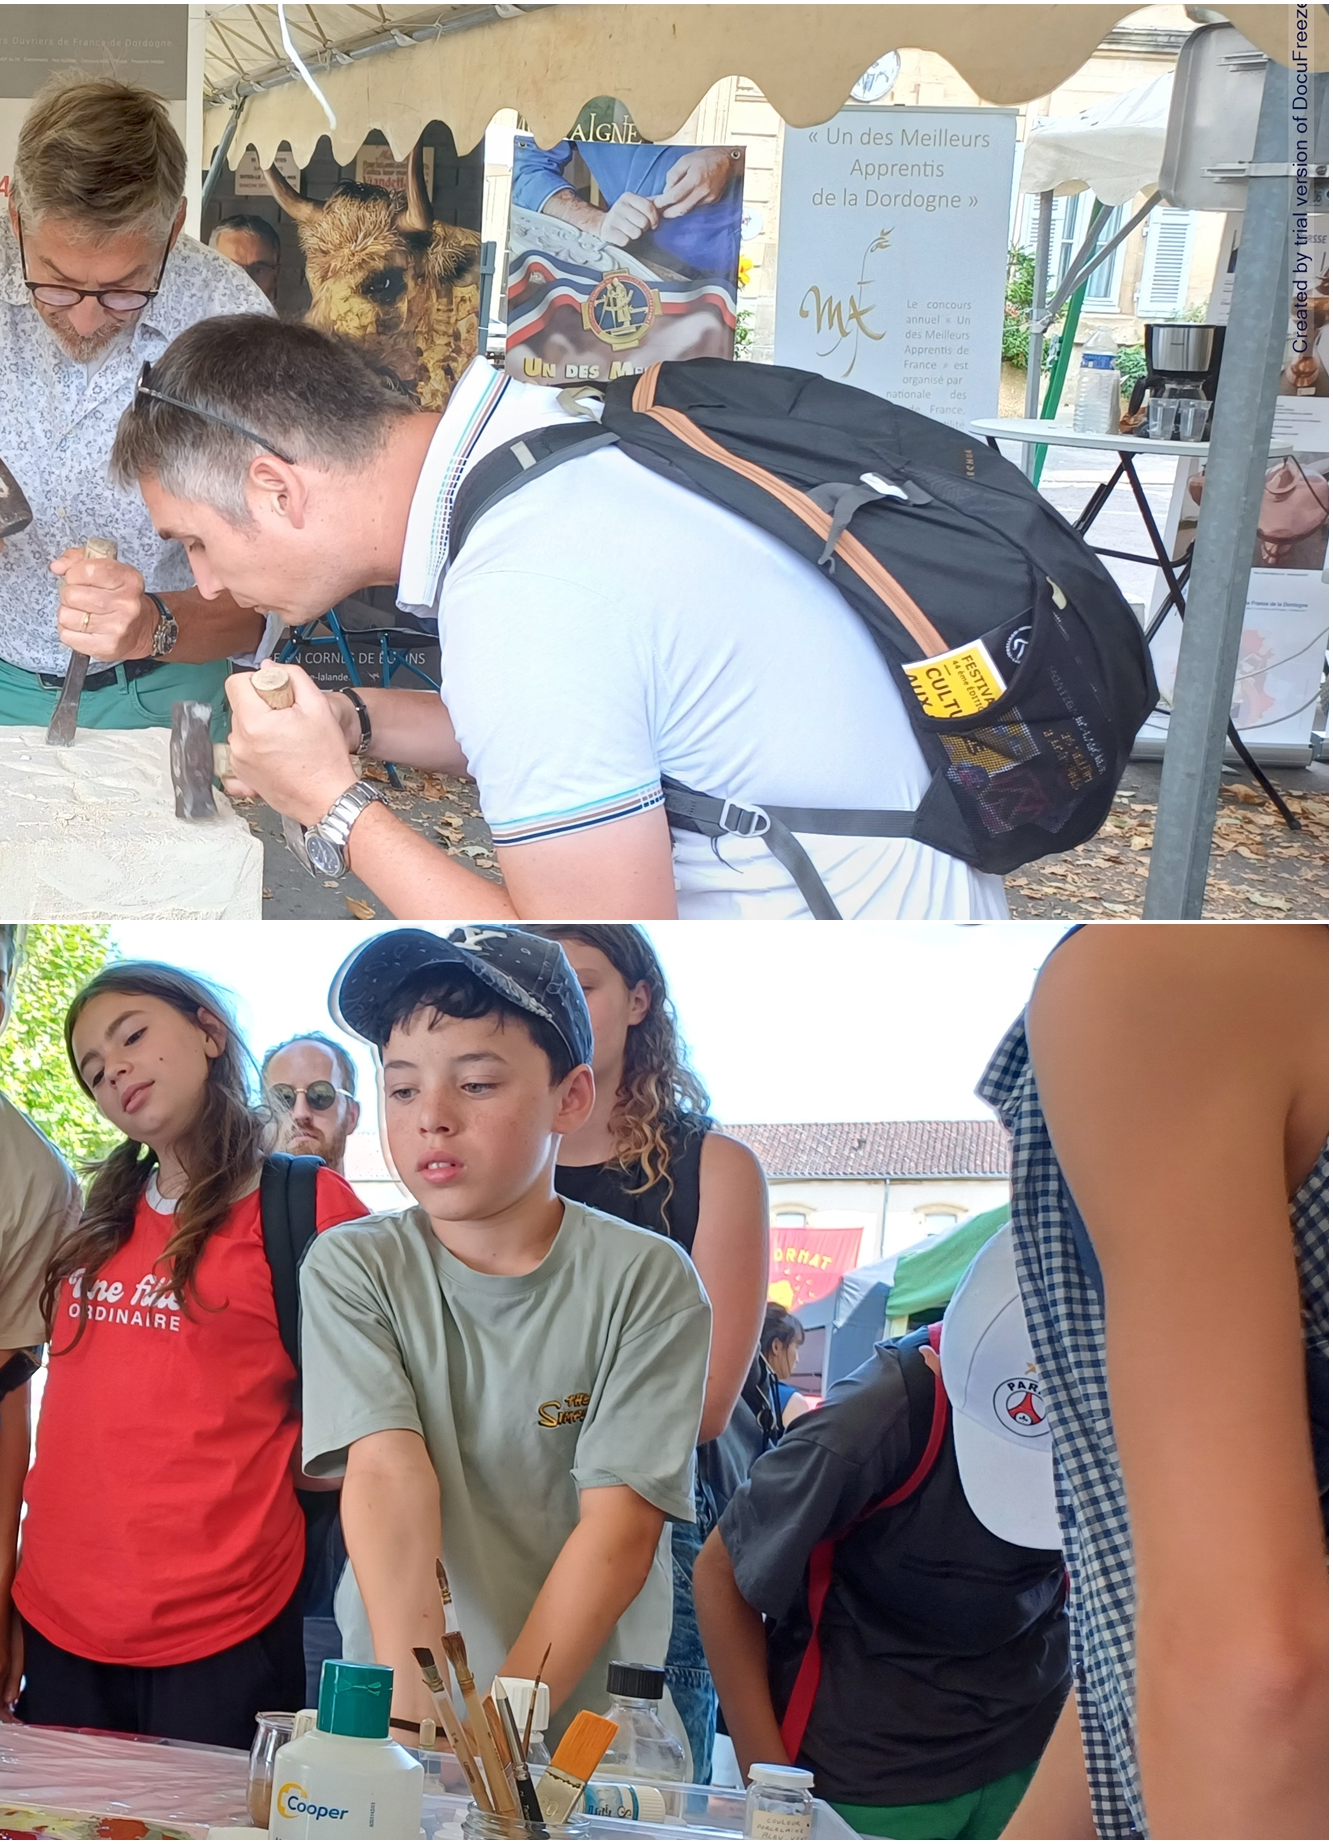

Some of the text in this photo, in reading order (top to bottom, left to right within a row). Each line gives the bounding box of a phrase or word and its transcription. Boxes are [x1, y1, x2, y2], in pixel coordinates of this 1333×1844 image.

[57, 37, 70, 46] de
[125, 38, 173, 49] Dordogne
[827, 128, 853, 146] Un
[860, 128, 893, 146] des
[901, 128, 990, 148] Meilleurs
[850, 158, 945, 180] Apprentis
[812, 187, 836, 206] de
[843, 188, 858, 207] la
[866, 189, 961, 212] Dordogne
[907, 300, 972, 310] Le concours
[905, 314, 971, 326] annuel Un
[905, 330, 971, 340] des Meilleurs
[904, 345, 969, 356] Apprentis de
[903, 360, 969, 370] France est
[565, 365, 599, 379] DES
[903, 375, 963, 386] organisé par
[886, 389, 967, 400] nationale des
[929, 404, 966, 416] France,
[359, 652, 375, 664] DE
[69, 1302, 181, 1332] ORDINAIRE
[1007, 1380, 1041, 1395] PAR
[287, 1795, 349, 1821] Cooper
